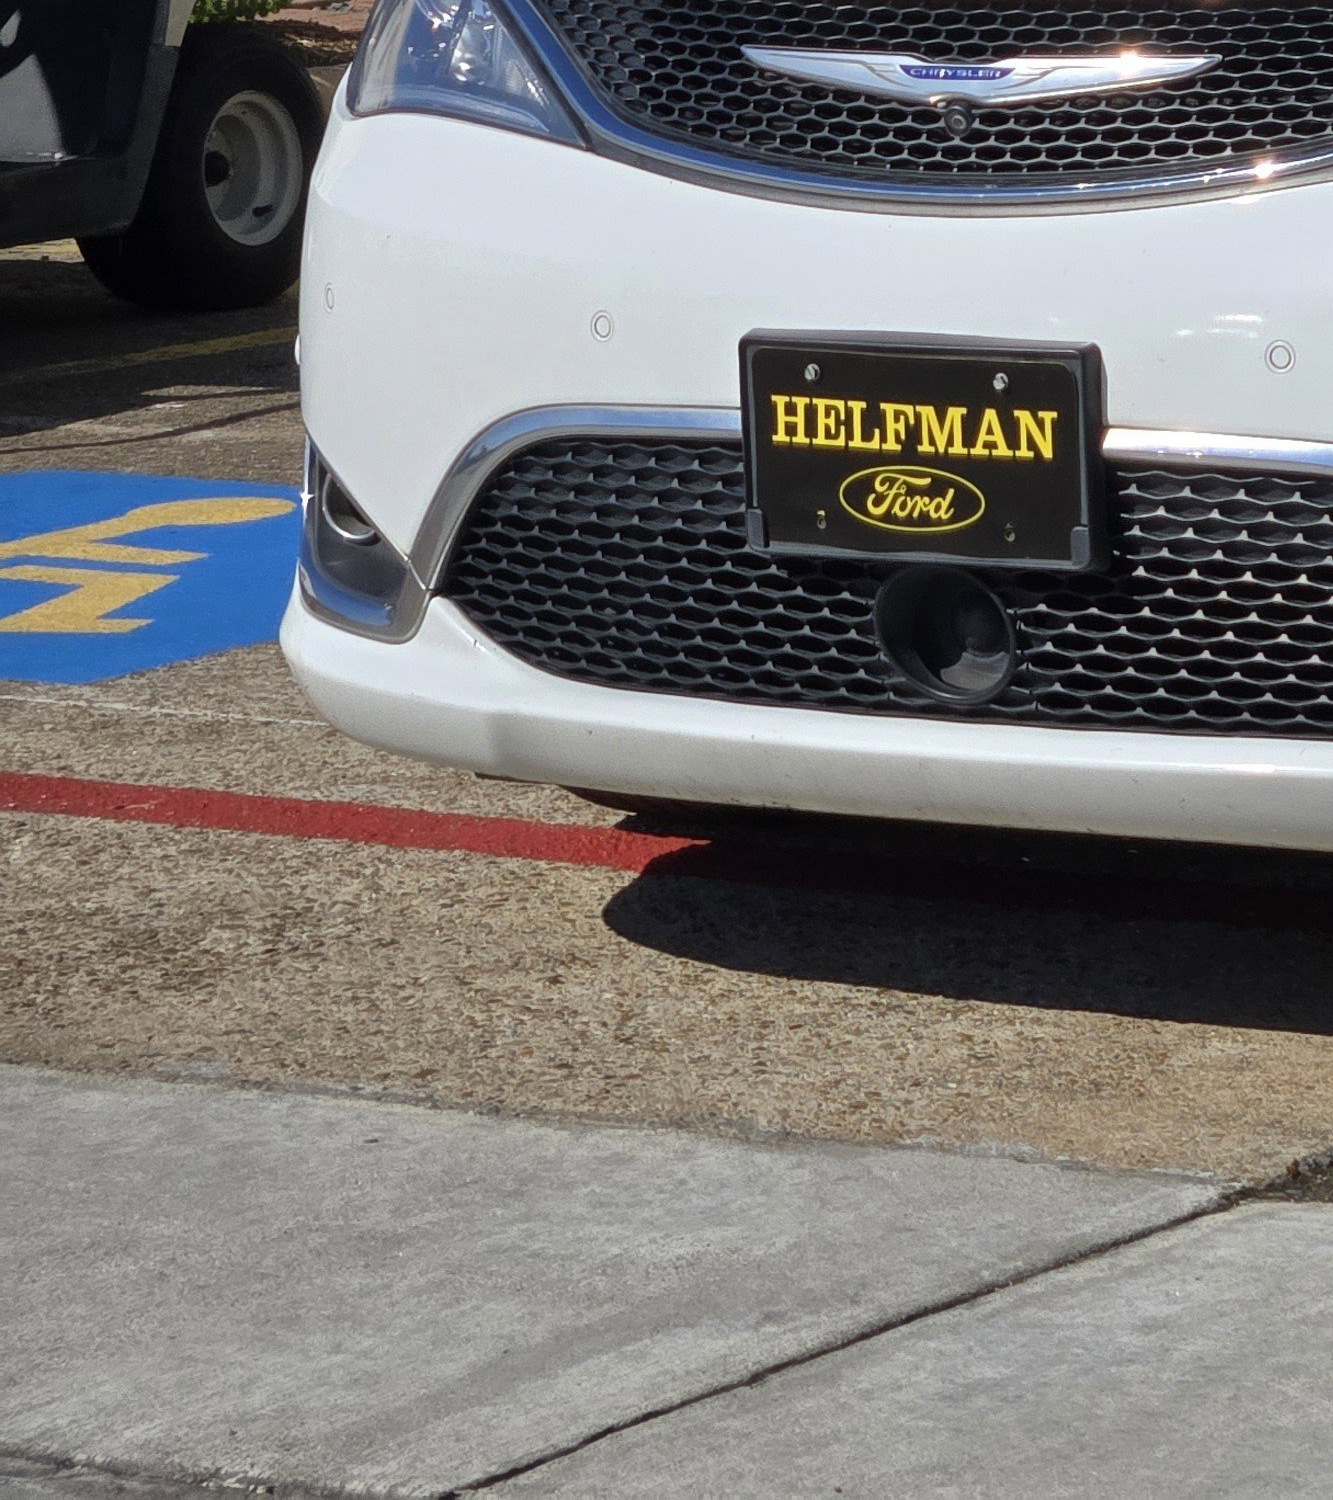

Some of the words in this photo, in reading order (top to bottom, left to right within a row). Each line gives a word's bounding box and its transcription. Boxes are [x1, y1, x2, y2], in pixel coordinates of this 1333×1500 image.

[909, 67, 1003, 79] CHRYSLER
[770, 395, 1058, 459] HELFMAN
[866, 473, 956, 521] Ford
